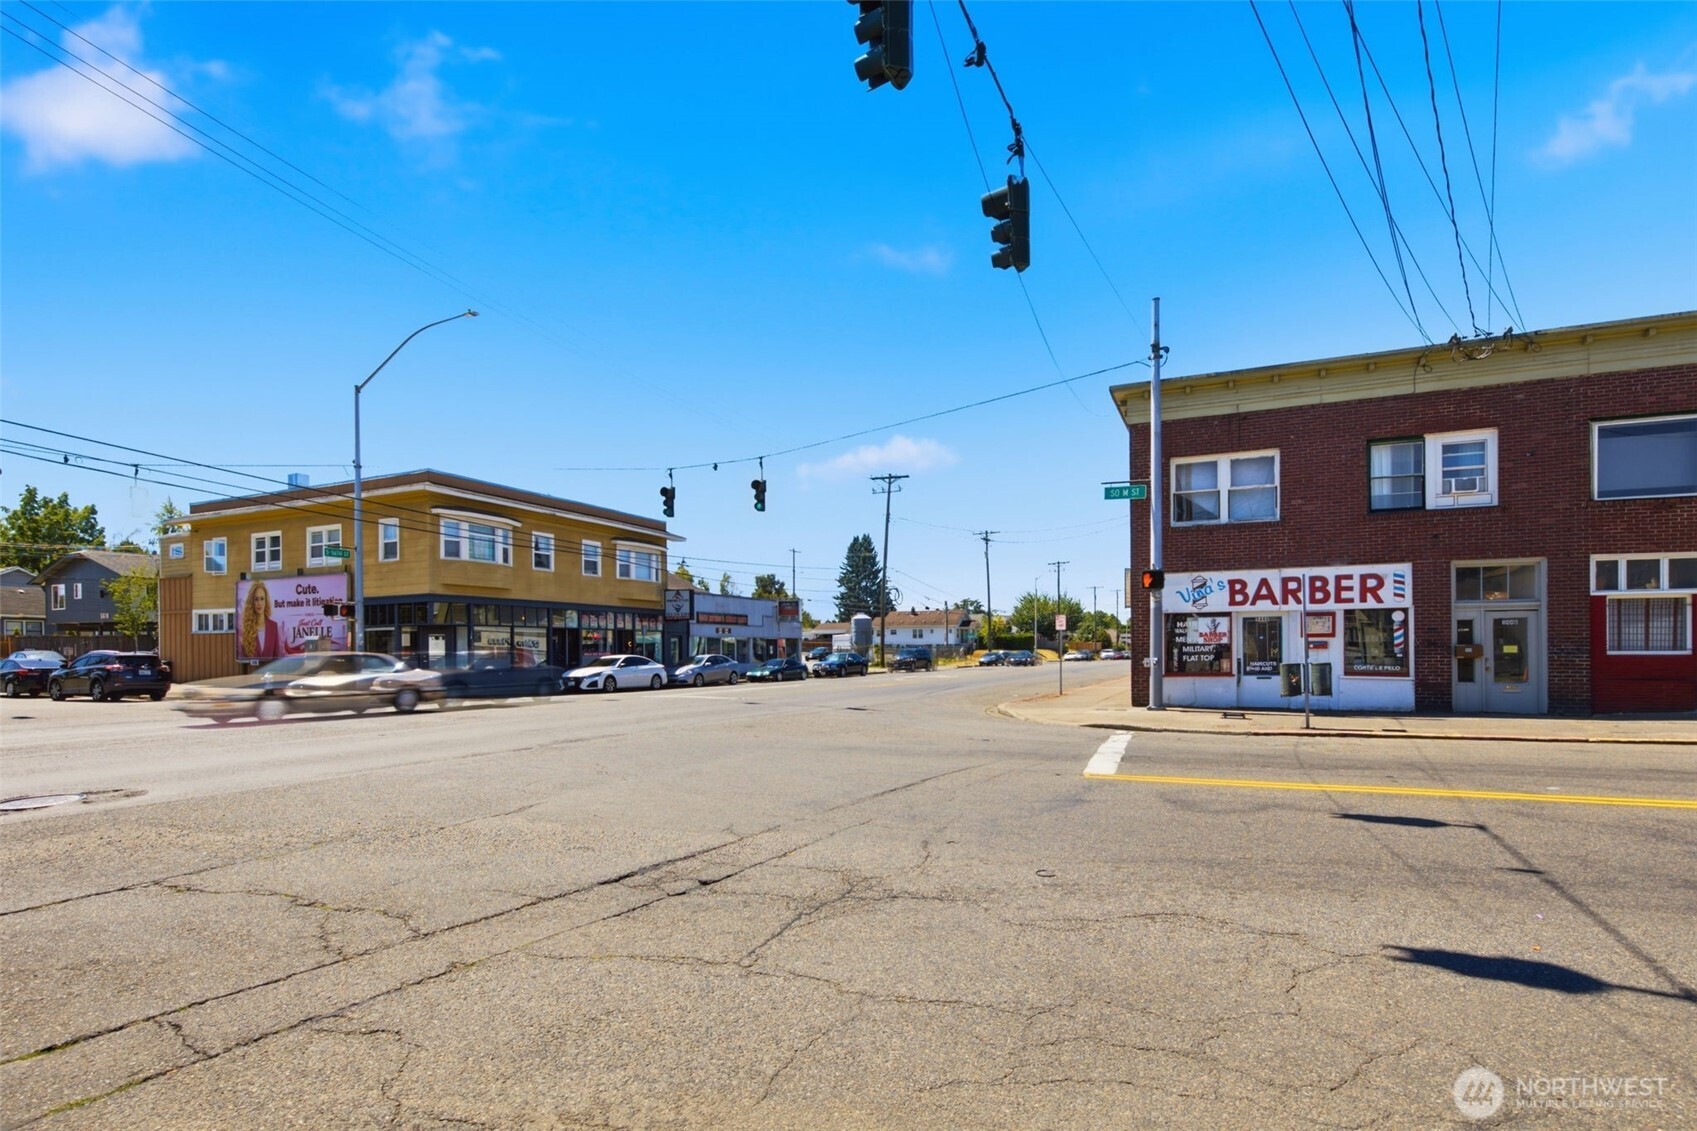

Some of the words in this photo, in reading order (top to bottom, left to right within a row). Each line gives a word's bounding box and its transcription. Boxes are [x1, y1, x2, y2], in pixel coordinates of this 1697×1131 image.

[1110, 489, 1120, 498] SO
[1122, 489, 1129, 497] M
[1131, 488, 1140, 496] ST
[295, 583, 319, 595] Cute.
[1175, 577, 1227, 603] Vina's
[1227, 573, 1385, 607] BARBER
[274, 600, 286, 608] But
[286, 598, 304, 608] make
[305, 598, 312, 607] it
